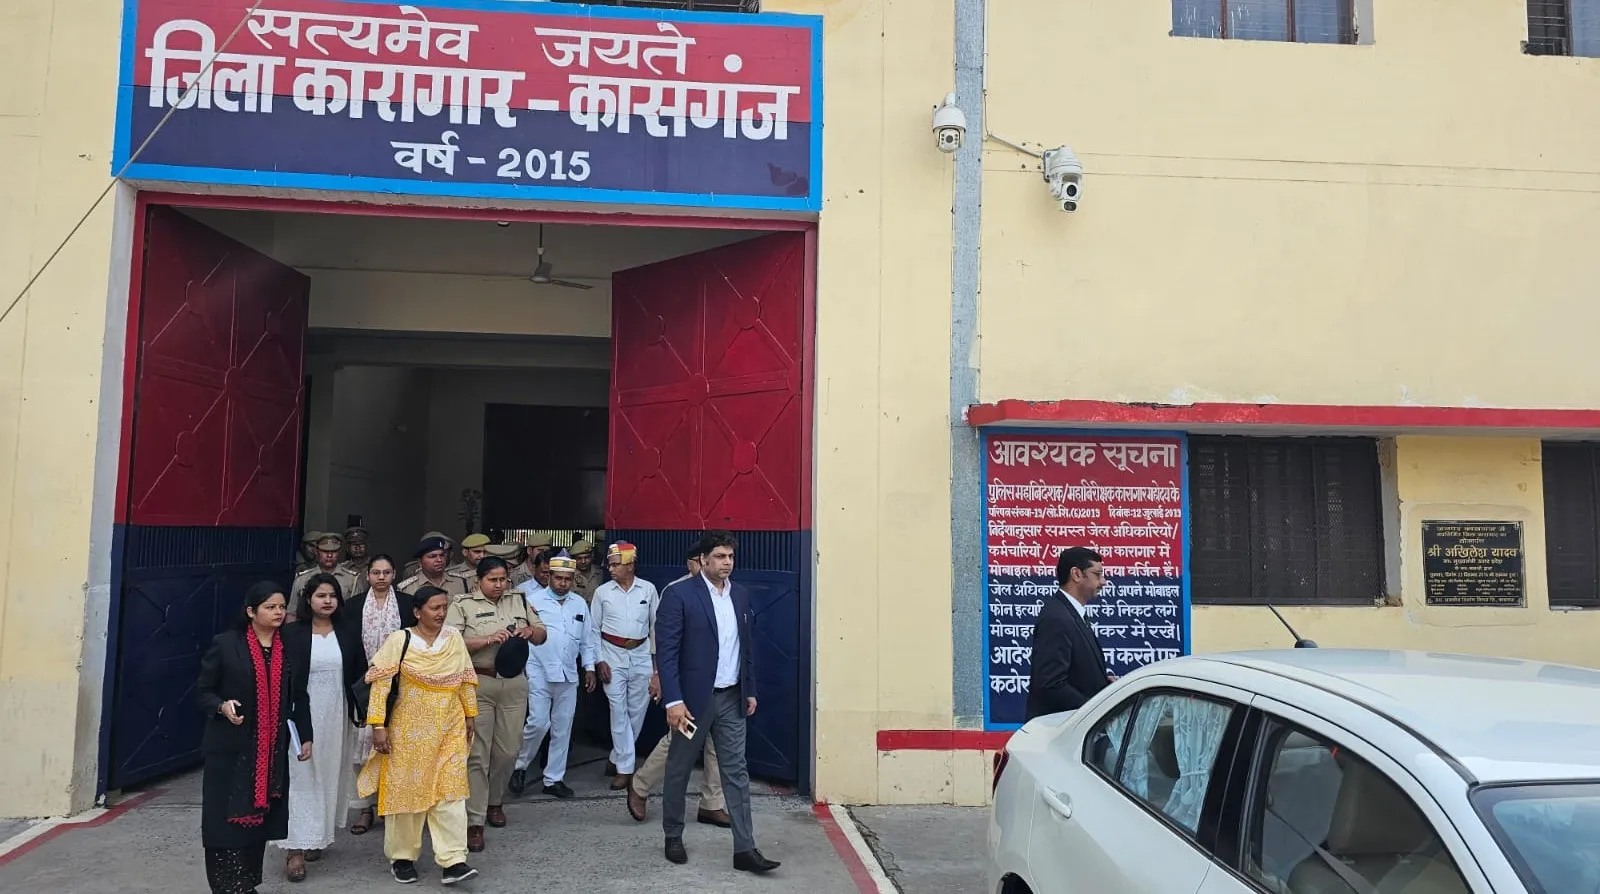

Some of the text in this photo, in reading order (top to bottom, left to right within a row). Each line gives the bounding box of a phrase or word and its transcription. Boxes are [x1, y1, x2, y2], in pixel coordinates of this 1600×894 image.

[247, 5, 696, 76] सत्यमेव जयते
[145, 19, 286, 113] जिला
[295, 56, 525, 129] कारागार
[569, 54, 801, 141] कासगंज
[392, 130, 460, 176] वर्ष
[497, 147, 592, 182] 2015
[989, 440, 1178, 474] आवश्यक सूचना
[988, 477, 1015, 503] पुलिस
[988, 520, 1042, 539] निर्देशानुसार
[1045, 525, 1085, 537] समस्त
[1087, 522, 1110, 537] जेल
[988, 540, 1043, 558] कर्मचारियों
[1100, 545, 1113, 557] का
[1114, 545, 1156, 558] कारागार
[1157, 541, 1171, 558] में
[1427, 544, 1520, 558] श्री अखिलेश यादव
[988, 560, 1032, 577] मोबाइल
[1032, 561, 1057, 577] फोन
[1126, 562, 1160, 578] वर्जित
[988, 579, 1012, 596] जेल
[1117, 580, 1142, 597] अपने
[1144, 580, 1180, 597] मोबाइल
[988, 598, 1013, 617] फोन
[1101, 599, 1115, 617] के
[1116, 599, 1153, 617] निकट
[1154, 600, 1178, 617] लगे
[1130, 619, 1146, 638] में
[1116, 641, 1156, 666] करने
[989, 668, 1031, 694] कठोर
